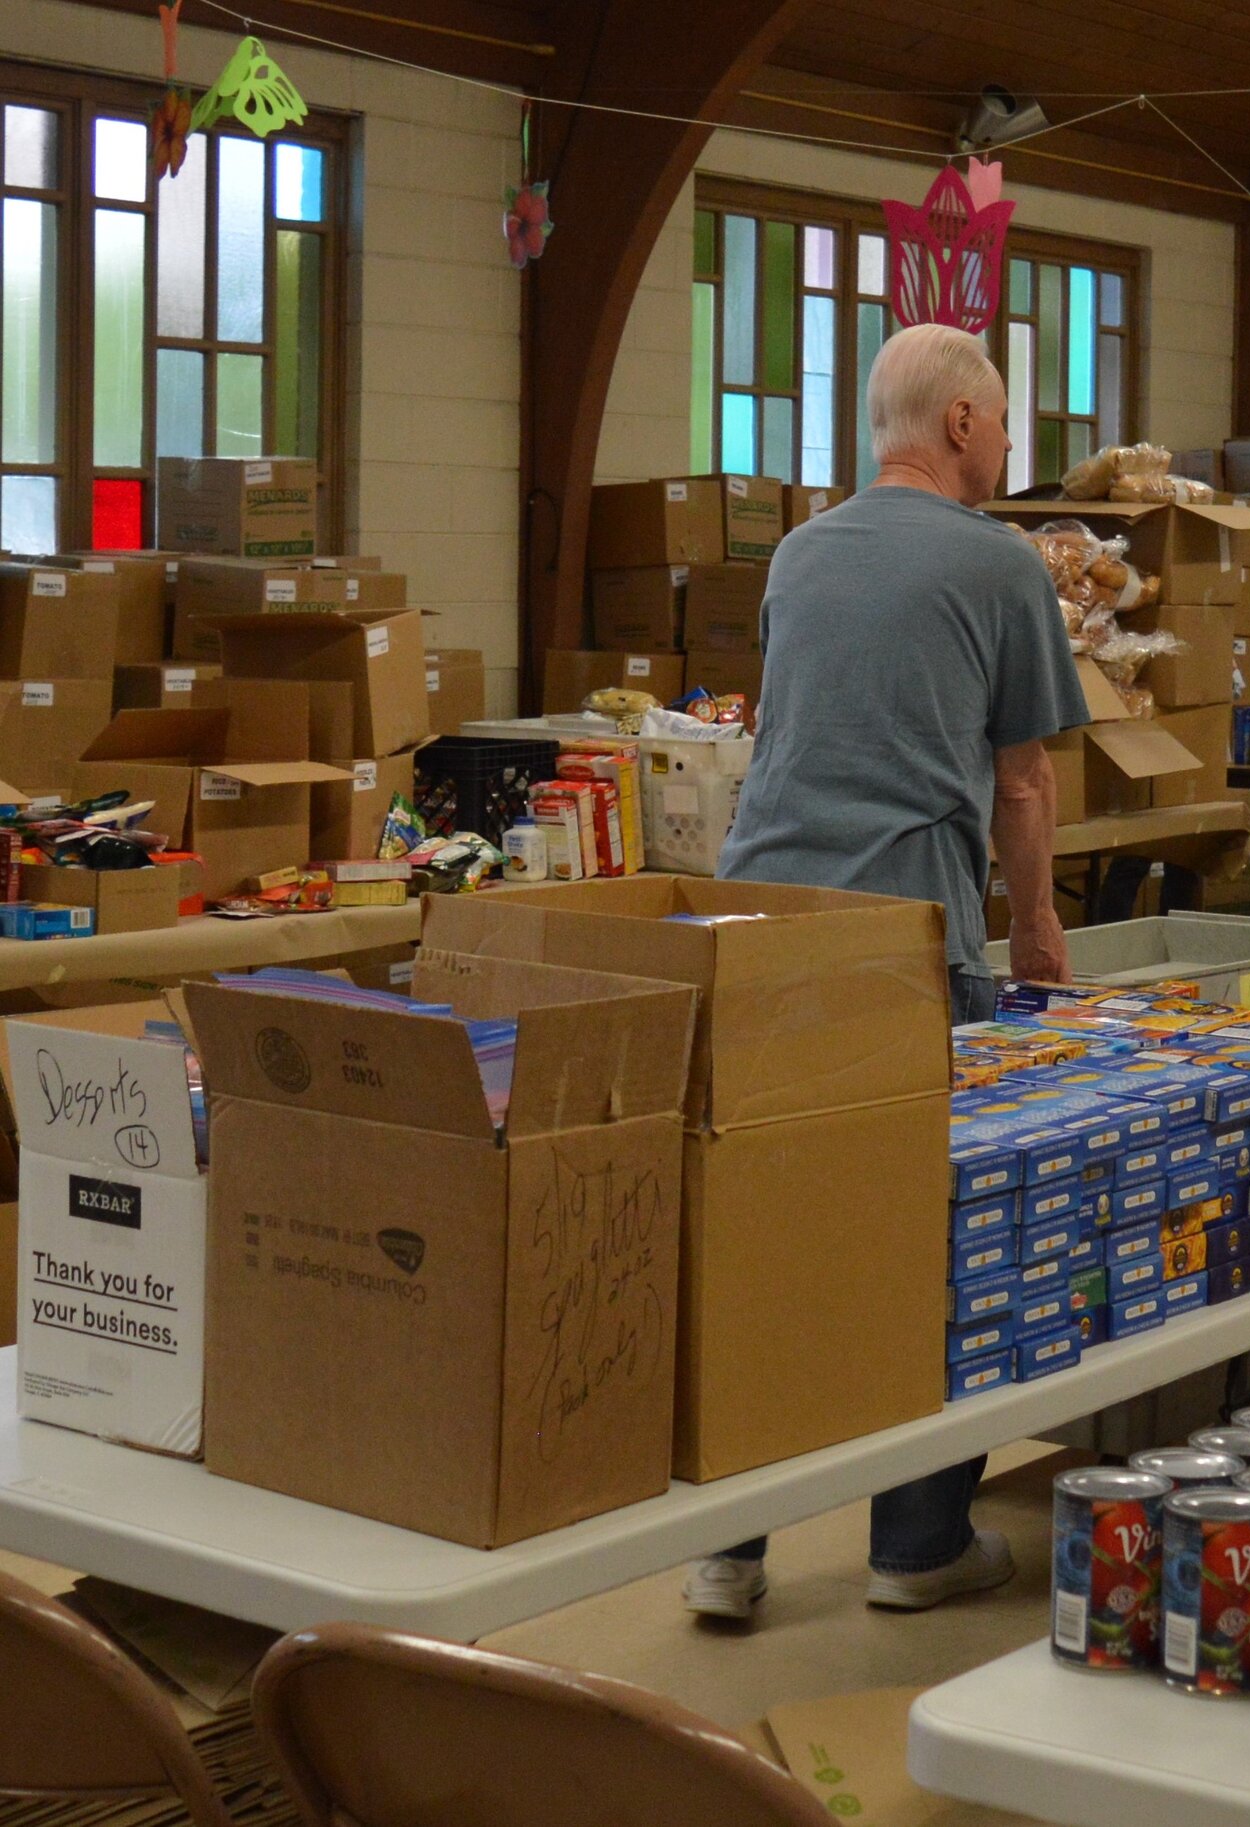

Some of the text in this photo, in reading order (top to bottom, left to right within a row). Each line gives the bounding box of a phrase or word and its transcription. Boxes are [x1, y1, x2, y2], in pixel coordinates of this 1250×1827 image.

[246, 489, 308, 503] MENARDS
[37, 582, 63, 590] TOMATO
[128, 1130, 149, 1160] 14
[79, 1190, 131, 1214] RXBAR
[33, 1250, 175, 1302] Thank you for
[32, 1298, 178, 1347] your business.
